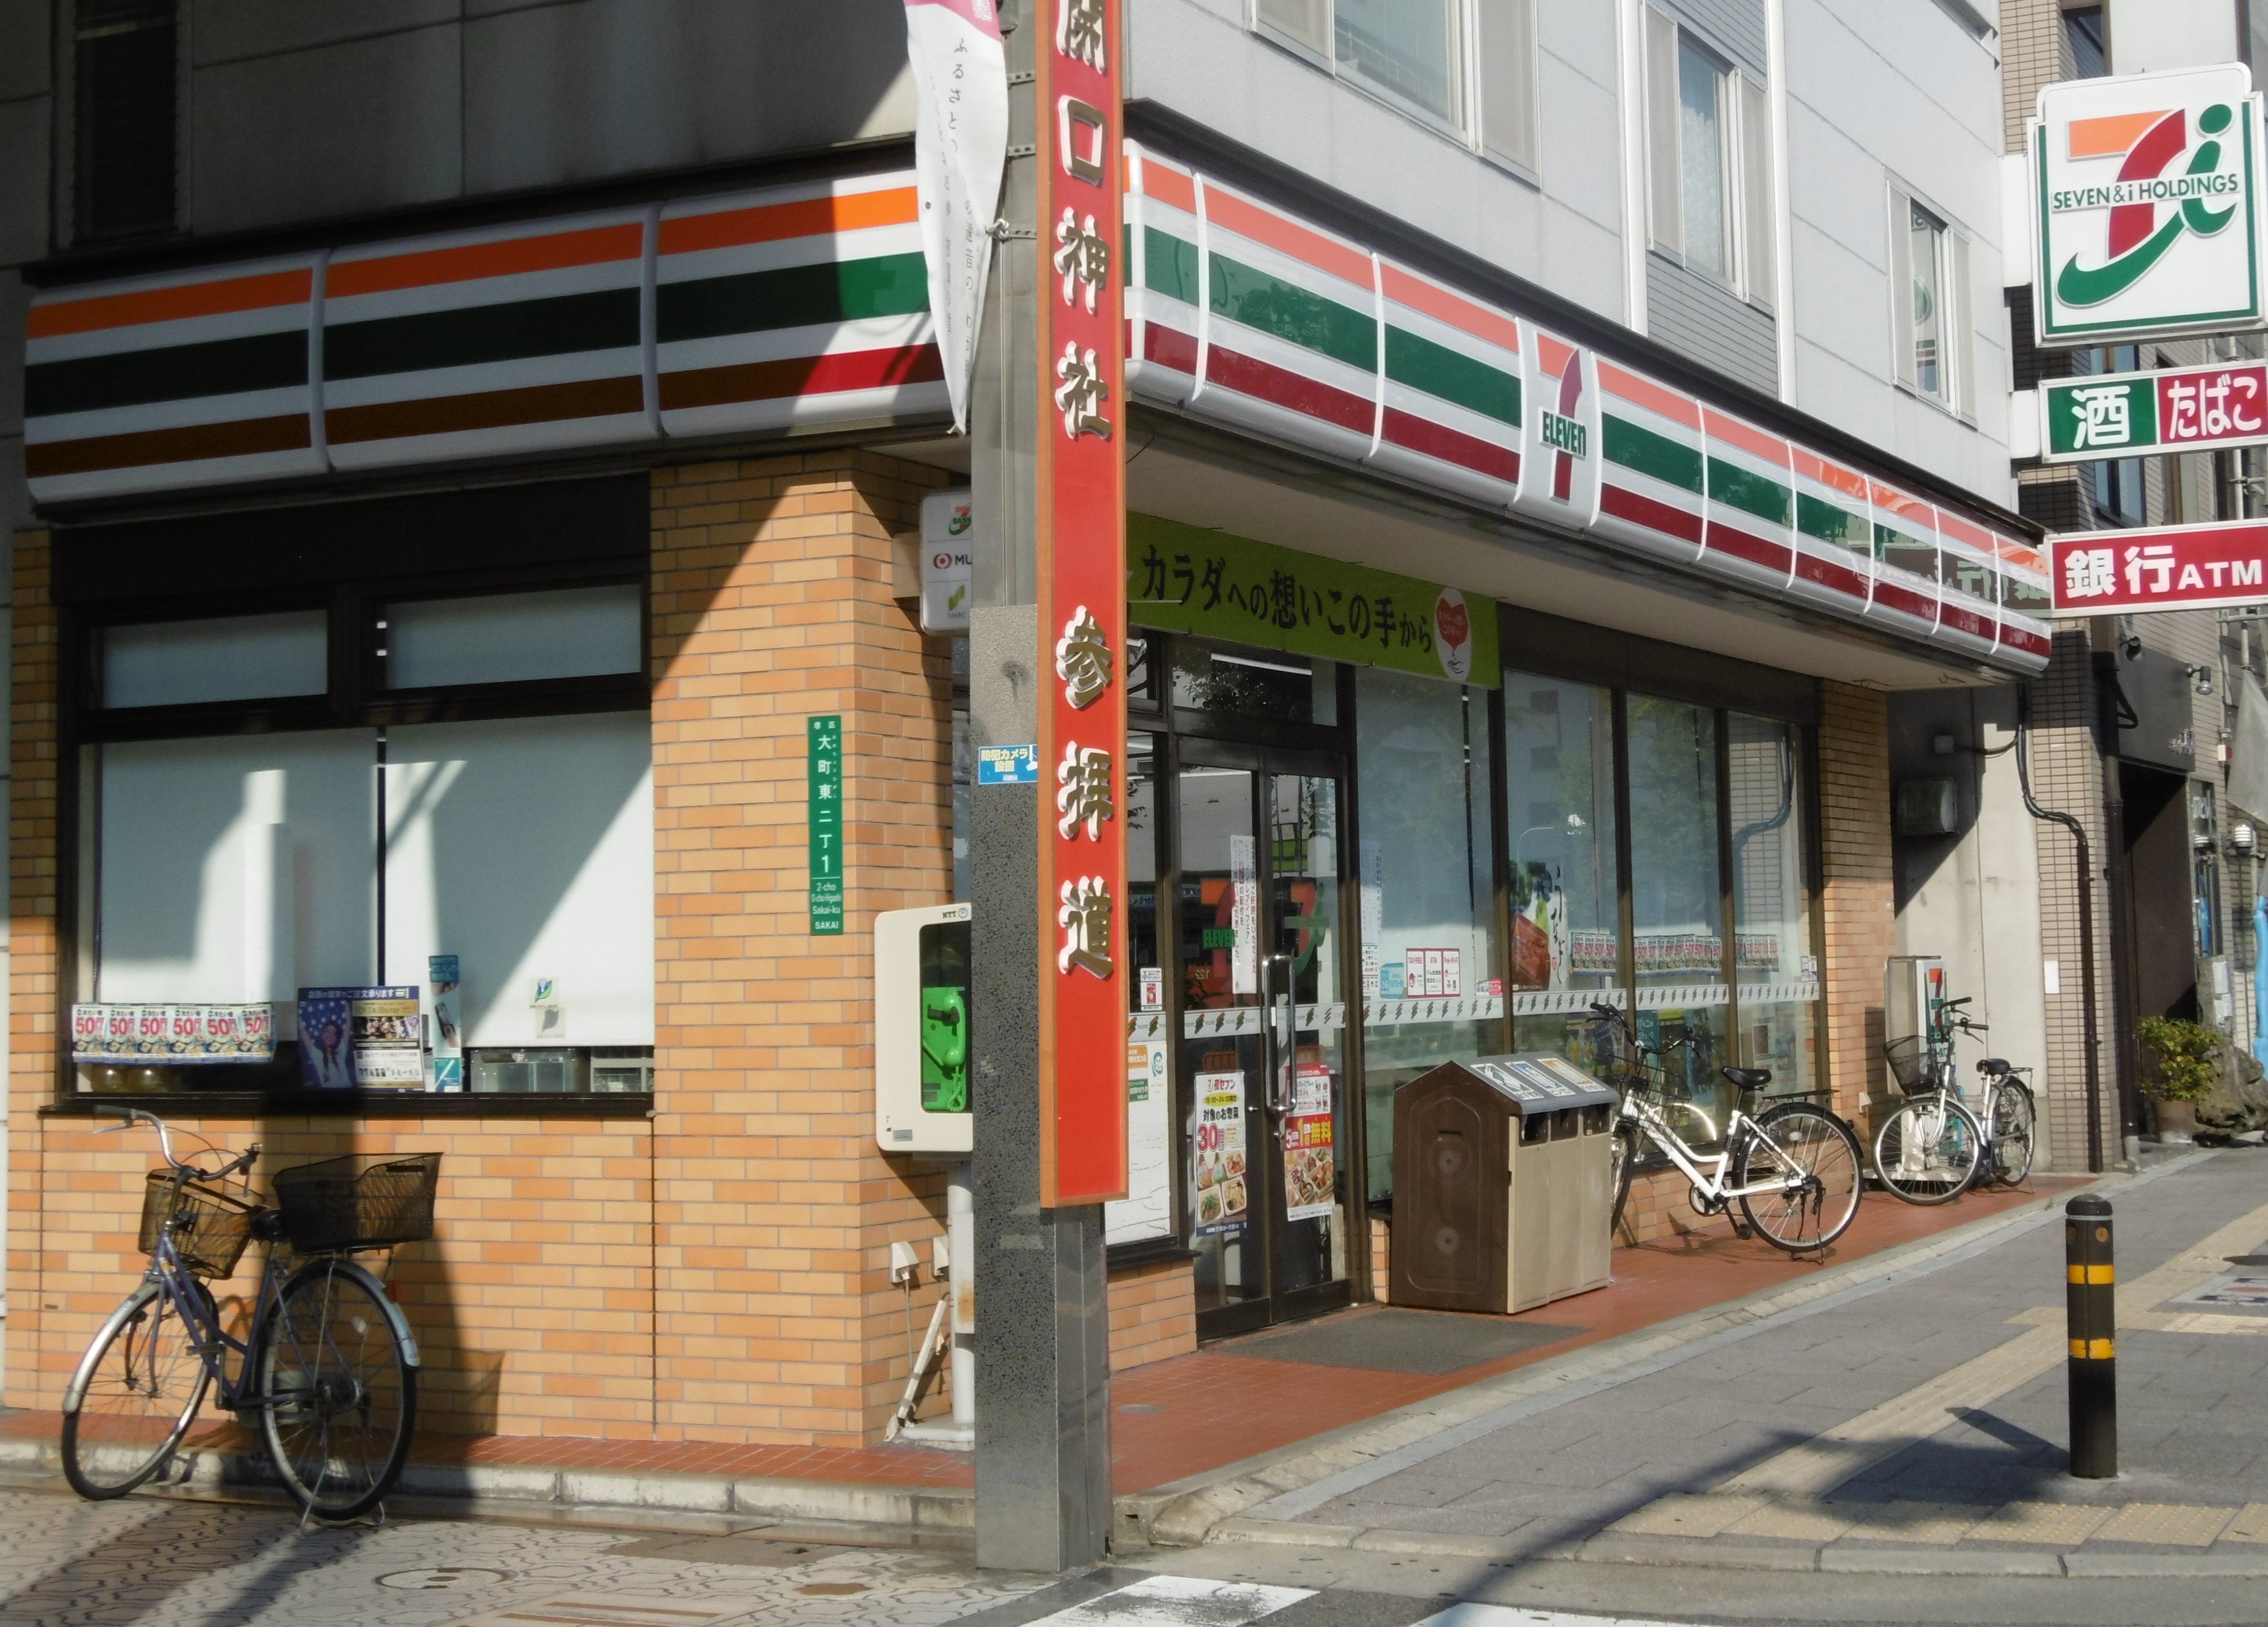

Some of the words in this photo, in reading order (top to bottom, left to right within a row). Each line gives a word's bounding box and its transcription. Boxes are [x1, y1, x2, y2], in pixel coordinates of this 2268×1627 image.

[2139, 173, 2238, 200] HOLDINGS
[2167, 373, 2262, 440] たばこ
[2071, 385, 2131, 449] 酒
[1142, 544, 1432, 653] カラダへの想いこの手から
[1056, 605, 1115, 980] 参拝道
[816, 882, 836, 891] 2-cho
[812, 905, 840, 915] Sakai-ku
[942, 911, 957, 919] NTT
[815, 921, 839, 930] SAKAI
[1214, 1079, 1236, 1091] 夜セブン
[1203, 1107, 1239, 1122] 対象のお惣菜
